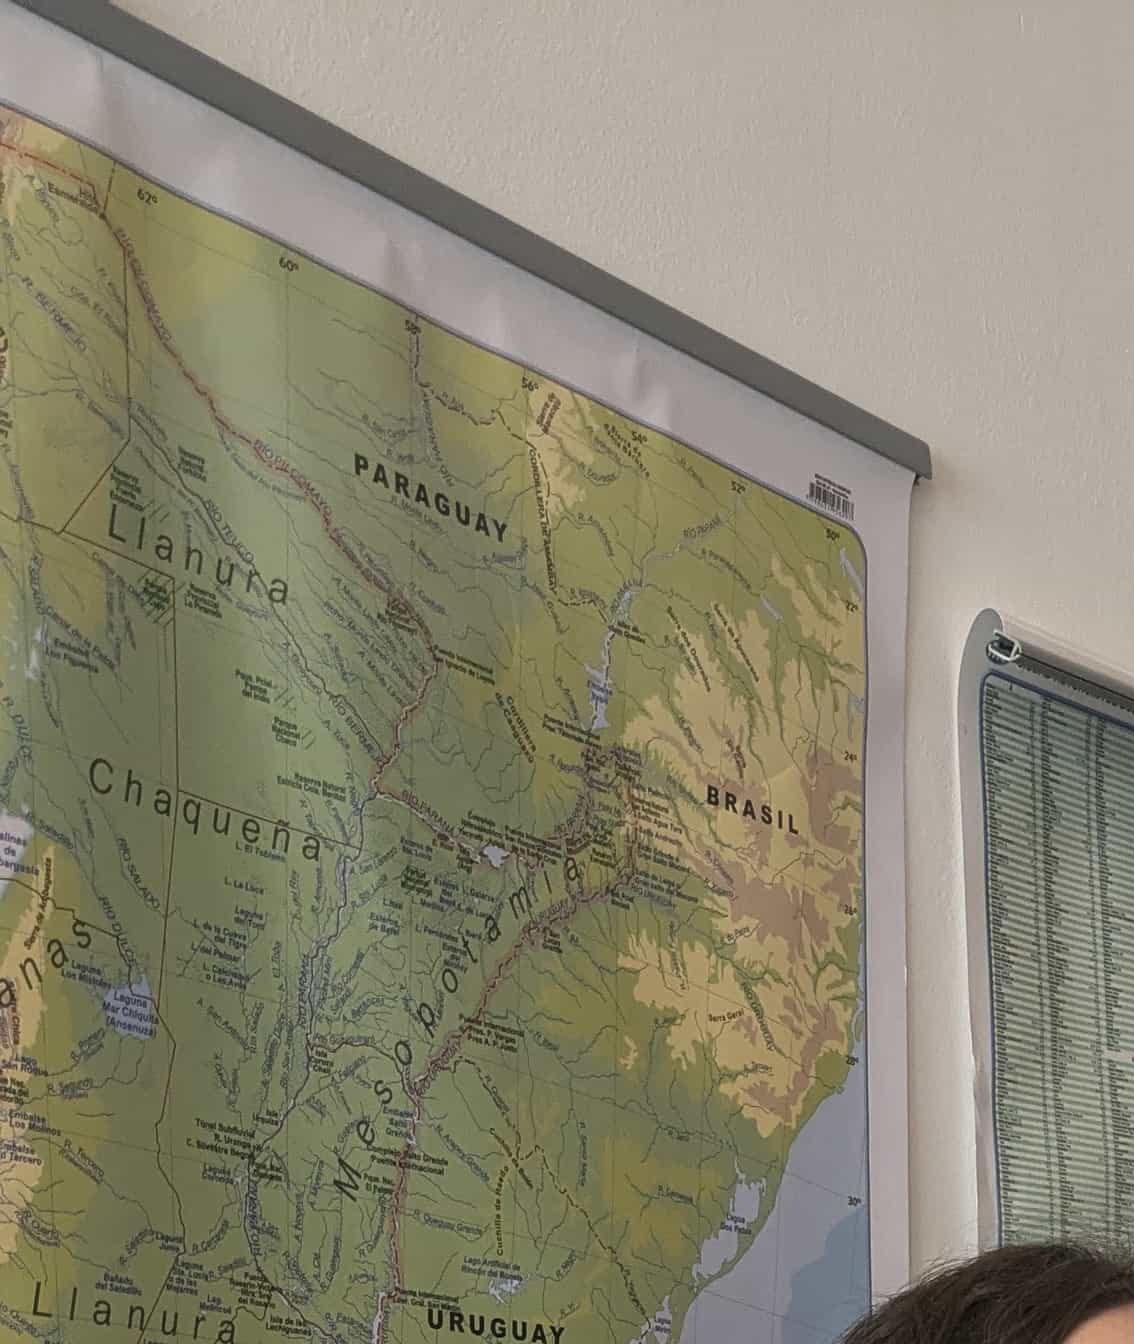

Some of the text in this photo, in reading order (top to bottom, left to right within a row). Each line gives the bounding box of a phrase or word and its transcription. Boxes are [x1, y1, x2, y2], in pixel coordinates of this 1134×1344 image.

[353, 453, 508, 542] PARAGUAY
[108, 504, 289, 606] Llanura
[89, 758, 320, 862] Chaqueña
[707, 784, 799, 834] BRASIL
[32, 1281, 236, 1344] Llanura
